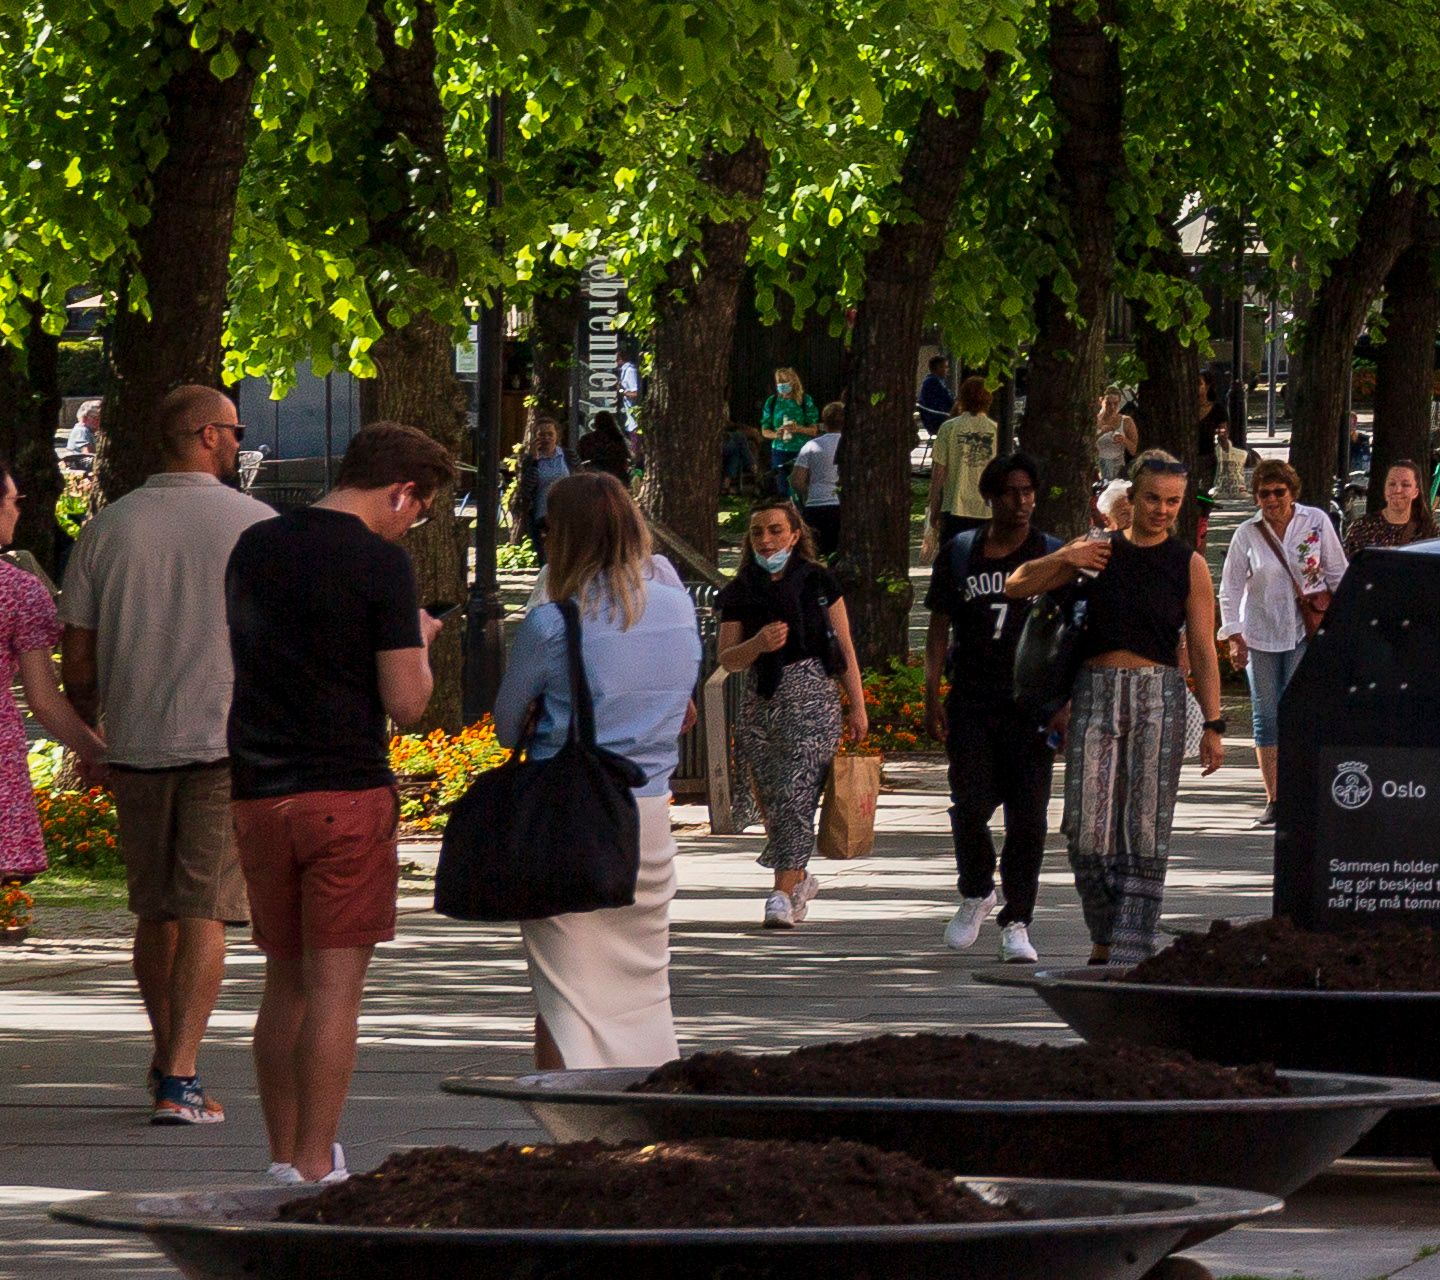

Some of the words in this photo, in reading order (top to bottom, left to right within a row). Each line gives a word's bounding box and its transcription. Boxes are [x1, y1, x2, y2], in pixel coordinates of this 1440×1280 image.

[990, 603, 1008, 639] 7
[1381, 780, 1426, 798] Oslo
[1329, 858, 1390, 873] Sammen
[1393, 859, 1439, 874] holder
[1328, 877, 1353, 893] Jeg
[1356, 878, 1376, 893] gir
[1379, 878, 1433, 894] beskjed
[1328, 896, 1353, 908] når
[1355, 897, 1376, 911] jeg
[1379, 896, 1401, 908] må
